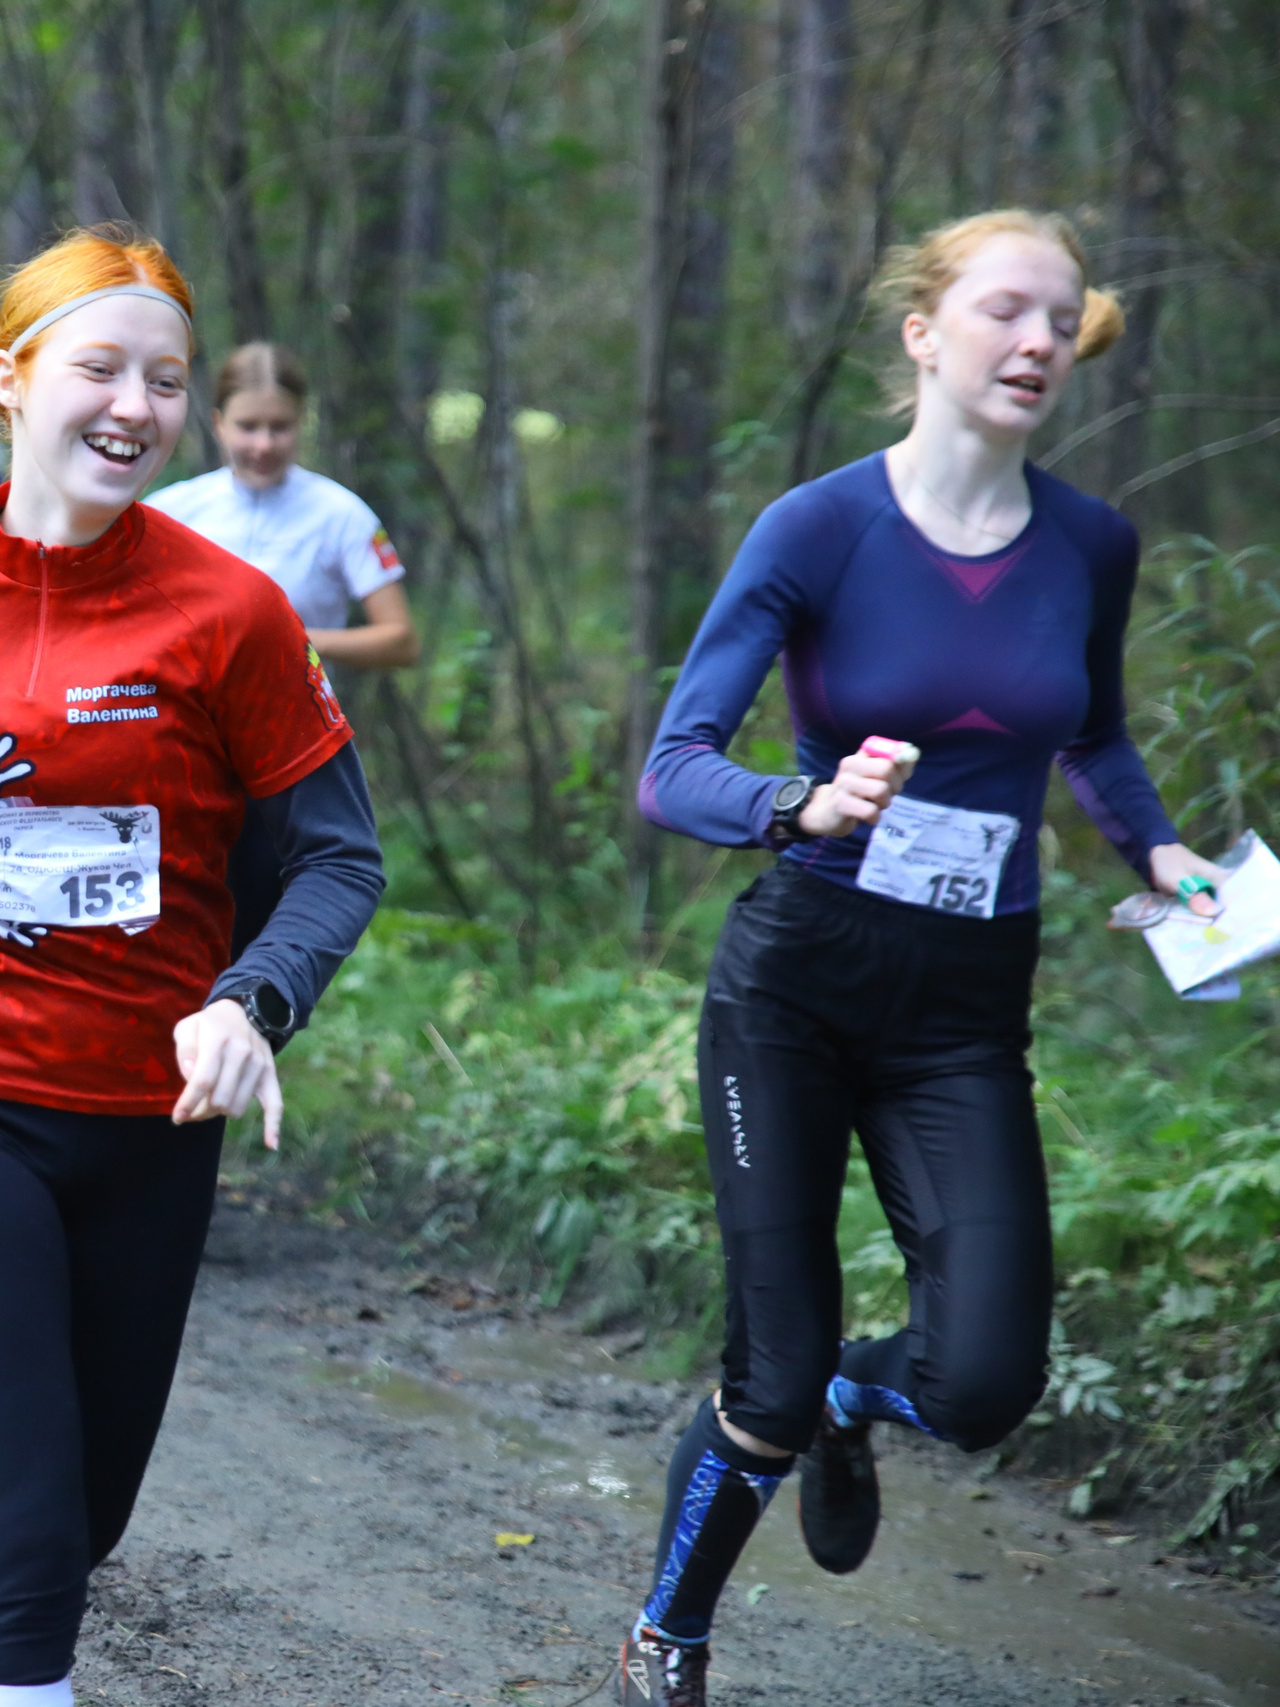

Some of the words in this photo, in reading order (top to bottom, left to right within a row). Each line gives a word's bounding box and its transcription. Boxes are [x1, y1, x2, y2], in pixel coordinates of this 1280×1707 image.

[66, 684, 157, 702] Моргачева
[67, 706, 158, 724] Валентина
[60, 871, 146, 919] 153
[929, 873, 989, 915] 152
